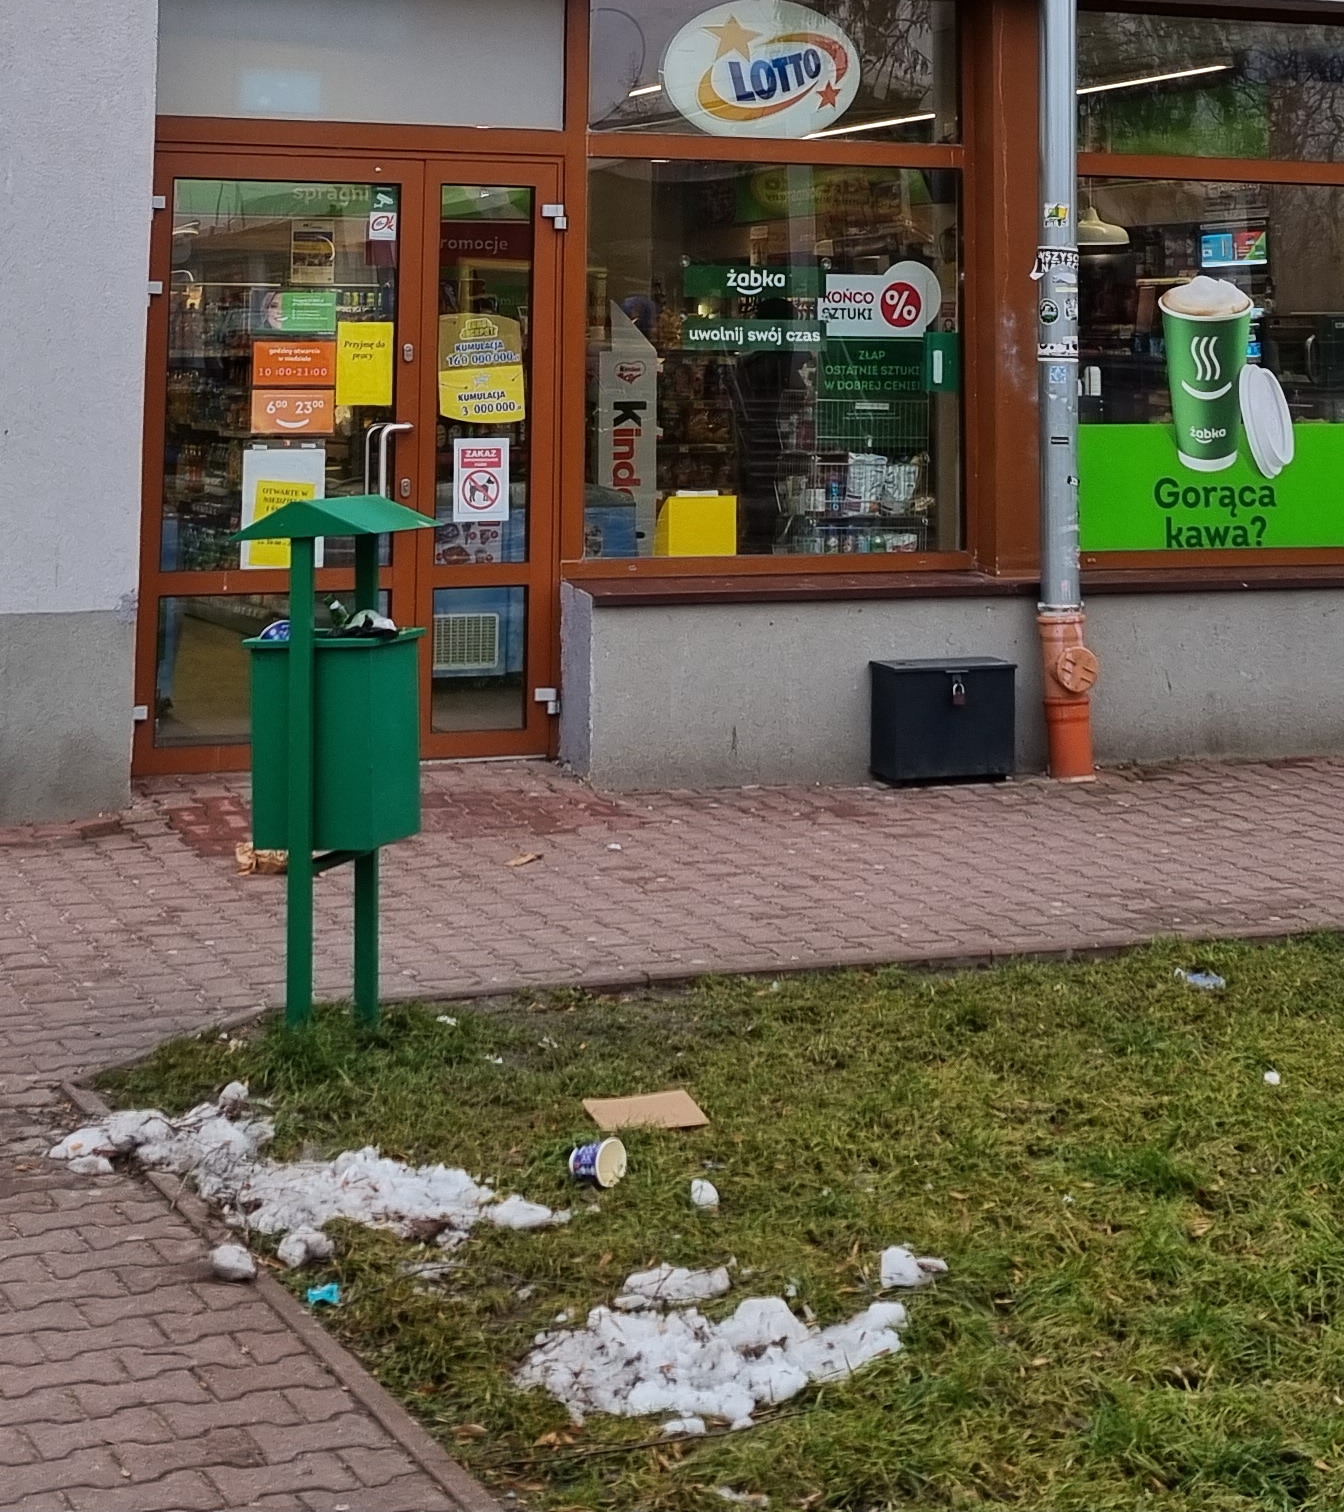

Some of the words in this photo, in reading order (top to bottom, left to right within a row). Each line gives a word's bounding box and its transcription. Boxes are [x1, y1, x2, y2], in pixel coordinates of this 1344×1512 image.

[728, 46, 822, 103] LOTTO
[441, 236, 508, 254] romocje
[726, 268, 786, 287] żabka
[689, 326, 744, 345] uwolnij
[748, 326, 782, 345] swój
[786, 330, 821, 342] czas
[456, 340, 505, 352] KUMULACJA
[472, 353, 492, 364] 000
[858, 350, 886, 361] ZŁAP
[825, 365, 878, 376] OSTATNIE
[881, 365, 920, 376] SZTUKI
[824, 380, 836, 390] W
[837, 380, 881, 391] DOBREJ
[458, 390, 506, 402] KUMULACJA
[462, 405, 469, 416] 3
[474, 403, 494, 414] 000
[496, 401, 515, 412] 000
[1190, 425, 1227, 439] żabka
[465, 449, 497, 458] ZAKAZ
[1154, 477, 1277, 518] Gorąca
[1165, 516, 1267, 549] kawa?
